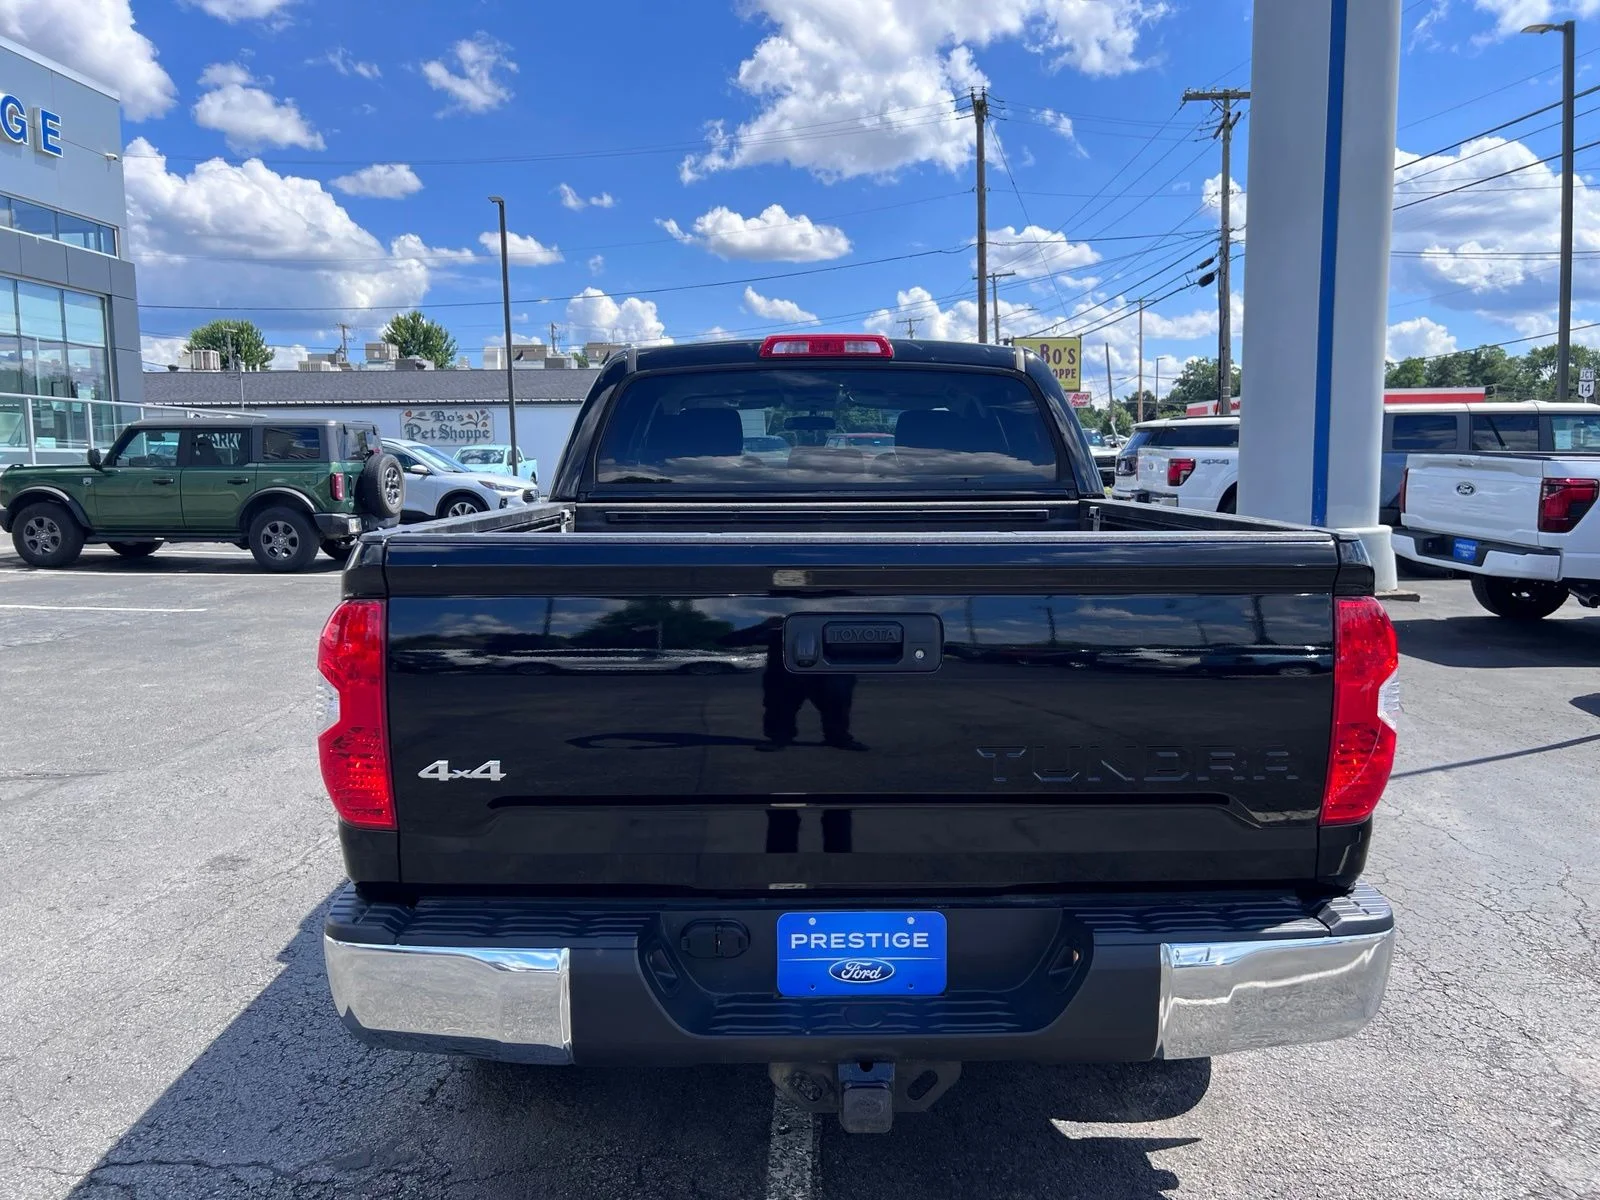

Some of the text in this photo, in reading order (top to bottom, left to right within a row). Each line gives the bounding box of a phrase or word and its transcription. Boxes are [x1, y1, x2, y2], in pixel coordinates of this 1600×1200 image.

[0, 94, 63, 158] GE
[1040, 344, 1076, 365] Bo's
[1581, 371, 1593, 379] JCT
[1581, 384, 1591, 394] 14
[431, 410, 465, 423] Bo's
[404, 423, 491, 442] Pet Shoppe
[831, 627, 898, 641] TOYOTA
[976, 745, 1299, 782] TUNDRA
[791, 932, 929, 949] PRESTIGE
[841, 961, 882, 980] Ford
